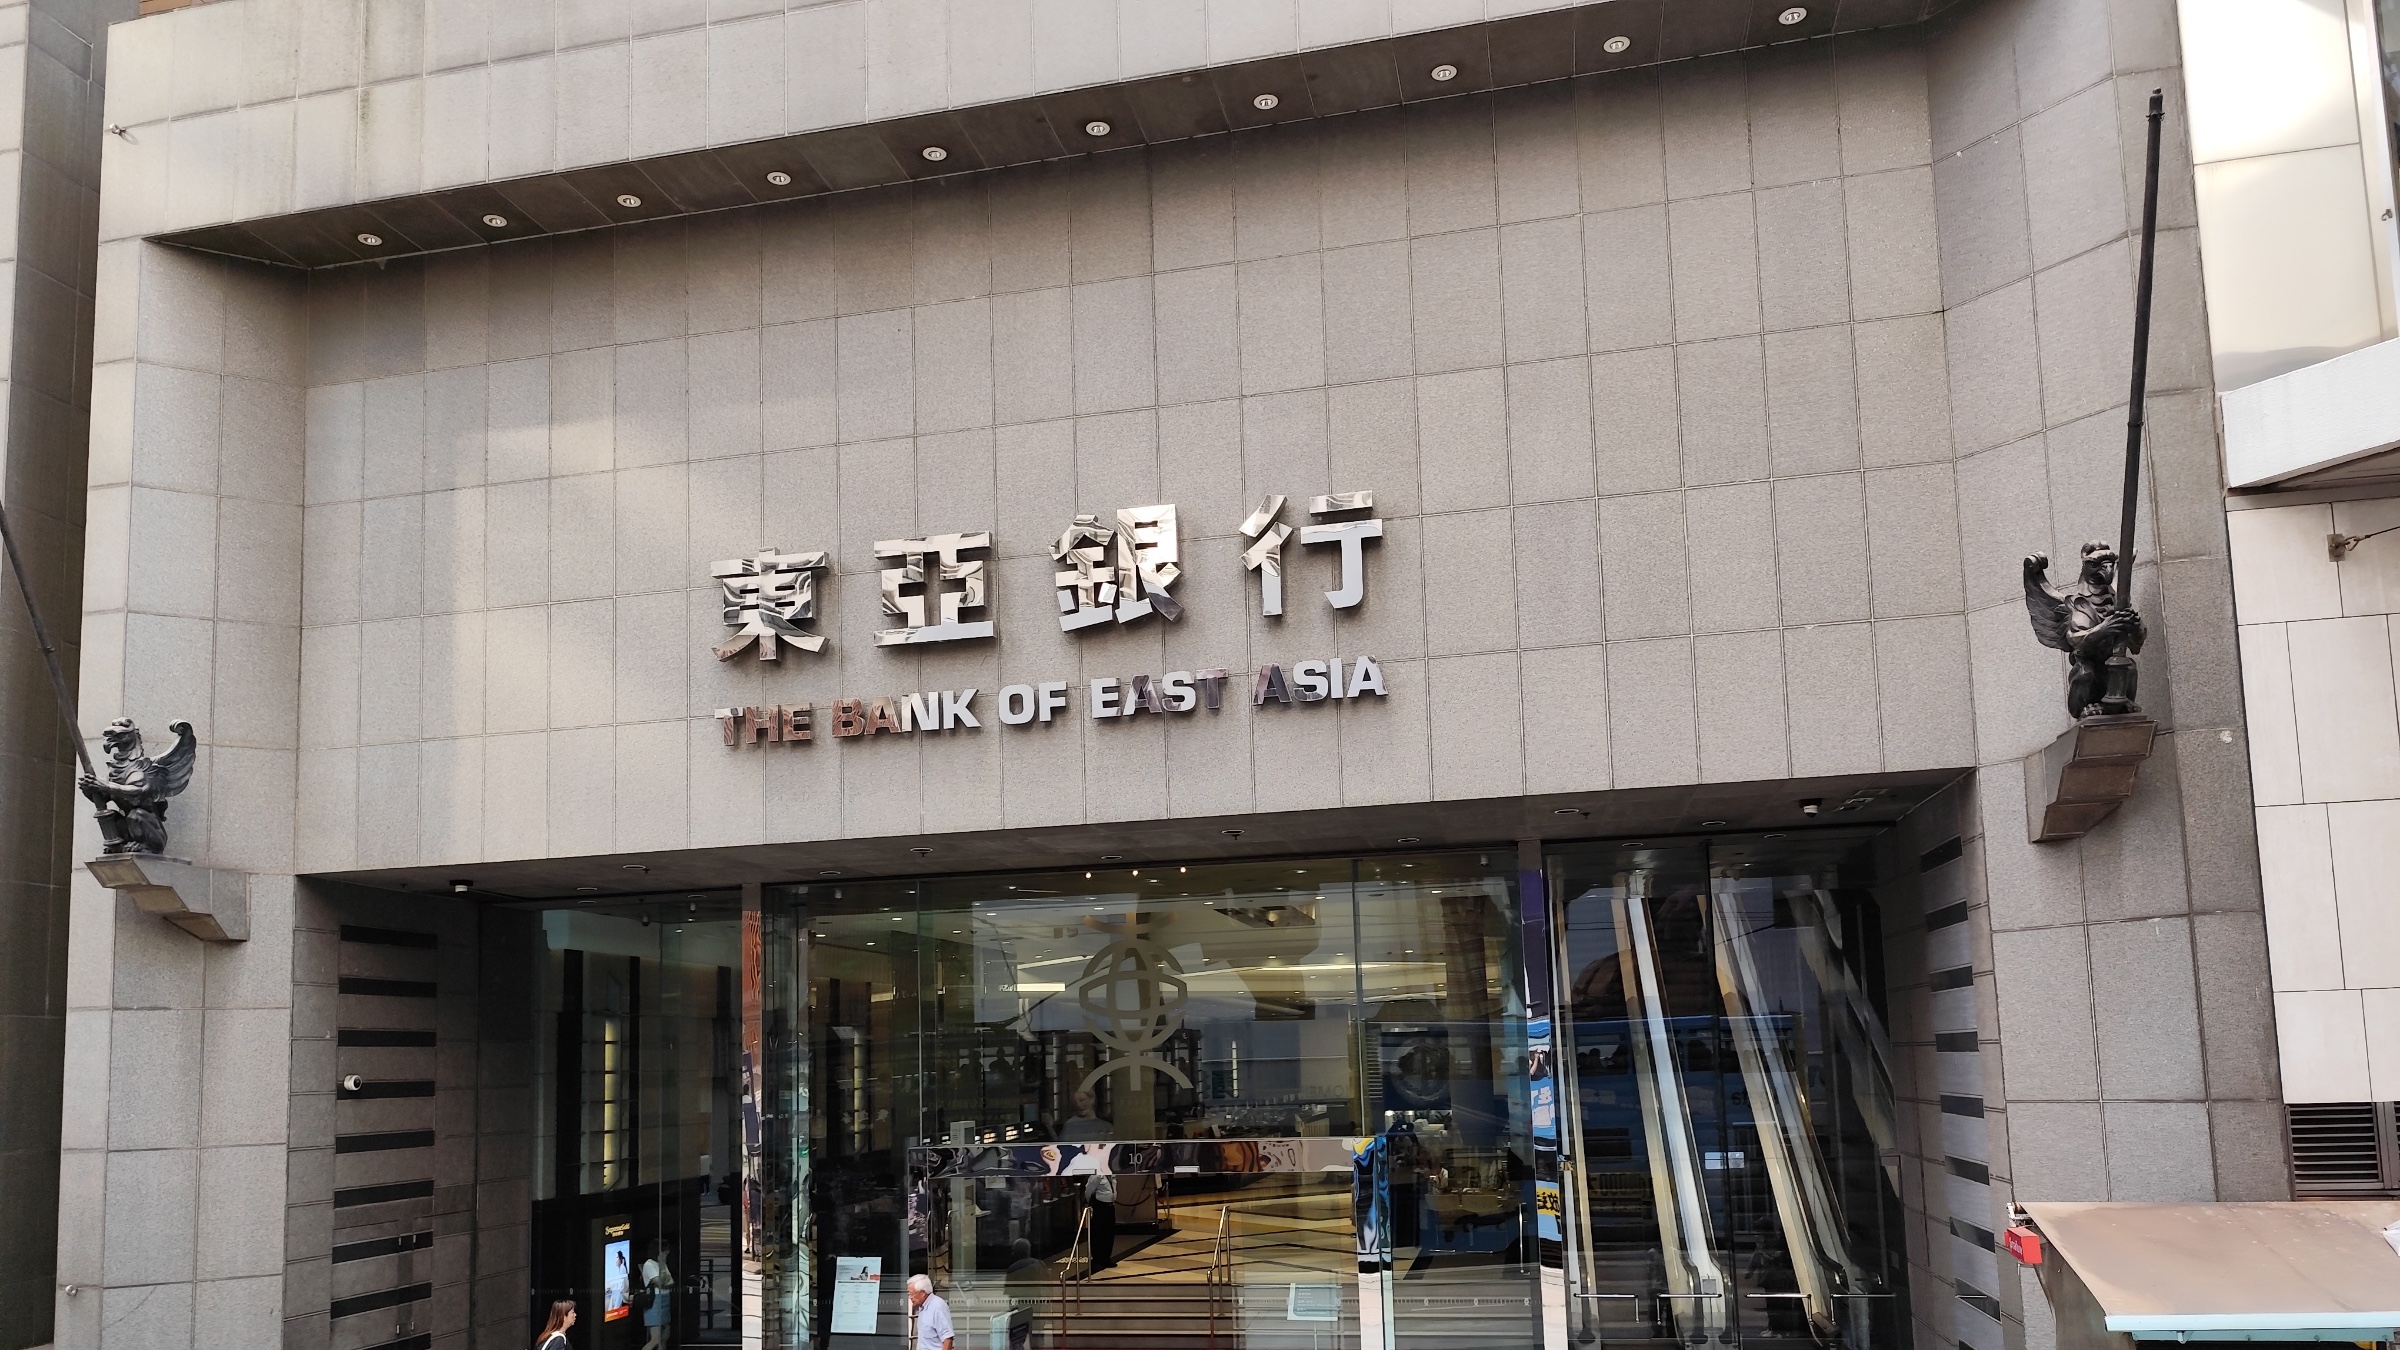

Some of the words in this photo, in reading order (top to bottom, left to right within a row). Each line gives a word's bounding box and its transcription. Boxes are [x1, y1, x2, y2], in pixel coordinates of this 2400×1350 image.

[710, 490, 1384, 662] 東亞銀行
[714, 702, 814, 747] THE
[830, 688, 983, 738] BANK
[997, 681, 1067, 727] OF
[1091, 667, 1228, 719] EAST
[1253, 655, 1390, 706] ASIA
[1128, 1153, 1143, 1165] 10
